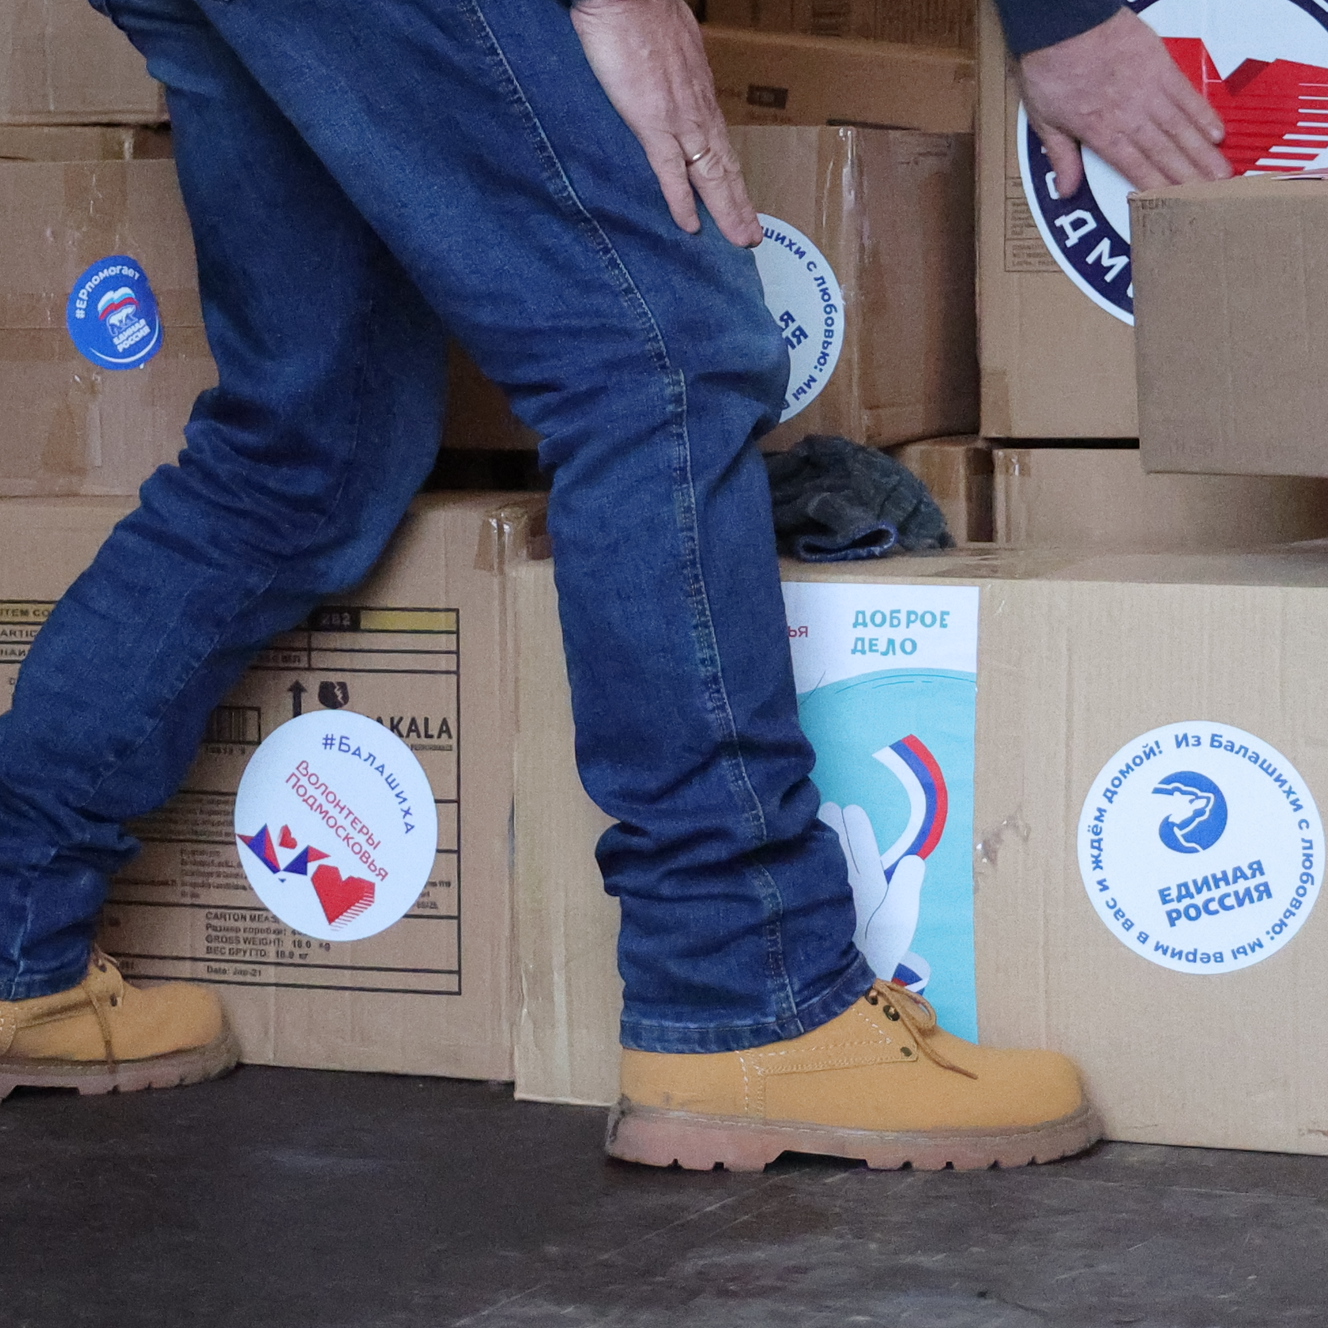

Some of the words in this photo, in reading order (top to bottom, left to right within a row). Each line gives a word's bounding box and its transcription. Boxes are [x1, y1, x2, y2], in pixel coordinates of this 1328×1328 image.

[806, 261, 818, 272] с
[75, 265, 140, 319] #ЕРпомогает
[813, 275, 838, 373] любовью:
[792, 374, 818, 402] мы
[0, 608, 29, 618] ITEM
[33, 609, 50, 618] CO
[852, 609, 951, 629] ДОБРОЕ
[0, 629, 38, 639] ARTIC
[850, 637, 918, 656] ДЕЛО
[1174, 733, 1201, 748] Из
[1103, 740, 1163, 804] домой!
[1209, 733, 1303, 812] Балашихи
[322, 733, 415, 835] #БАЛАШИХА
[1298, 819, 1309, 830] с
[1087, 807, 1106, 871] ждём
[1096, 878, 1110, 892] и
[1157, 859, 1266, 906] ЕДИНАЯ
[1266, 838, 1315, 941] любовью:
[1105, 898, 1135, 932] вас
[1165, 881, 1273, 928] РОССИЯ
[205, 912, 247, 923] CARTON
[205, 934, 241, 945] GROSS
[1137, 931, 1150, 944] в
[1231, 937, 1264, 960] мы
[1154, 940, 1224, 964] верим
